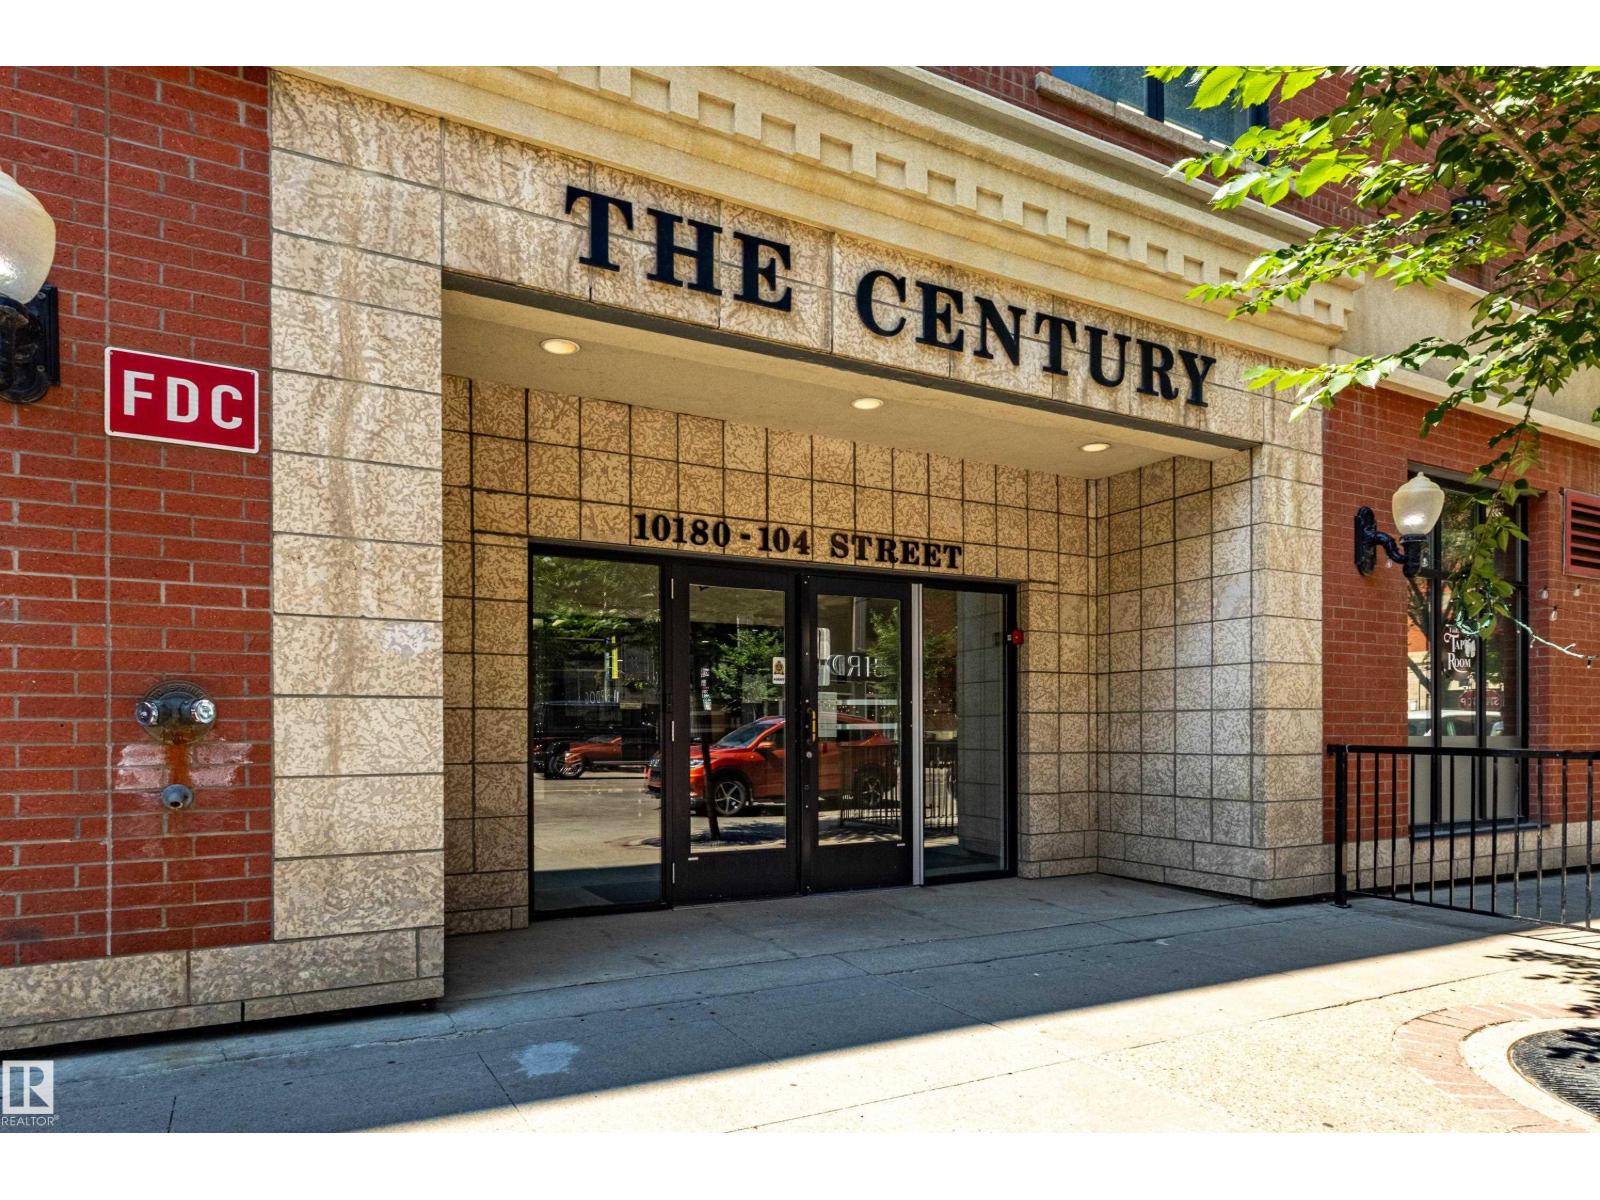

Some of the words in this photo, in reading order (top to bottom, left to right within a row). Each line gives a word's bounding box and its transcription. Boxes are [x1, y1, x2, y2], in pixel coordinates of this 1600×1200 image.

[566, 185, 792, 312] THE
[856, 269, 1216, 408] CENTURY
[123, 369, 243, 430] FDC
[830, 532, 963, 569] STREET
